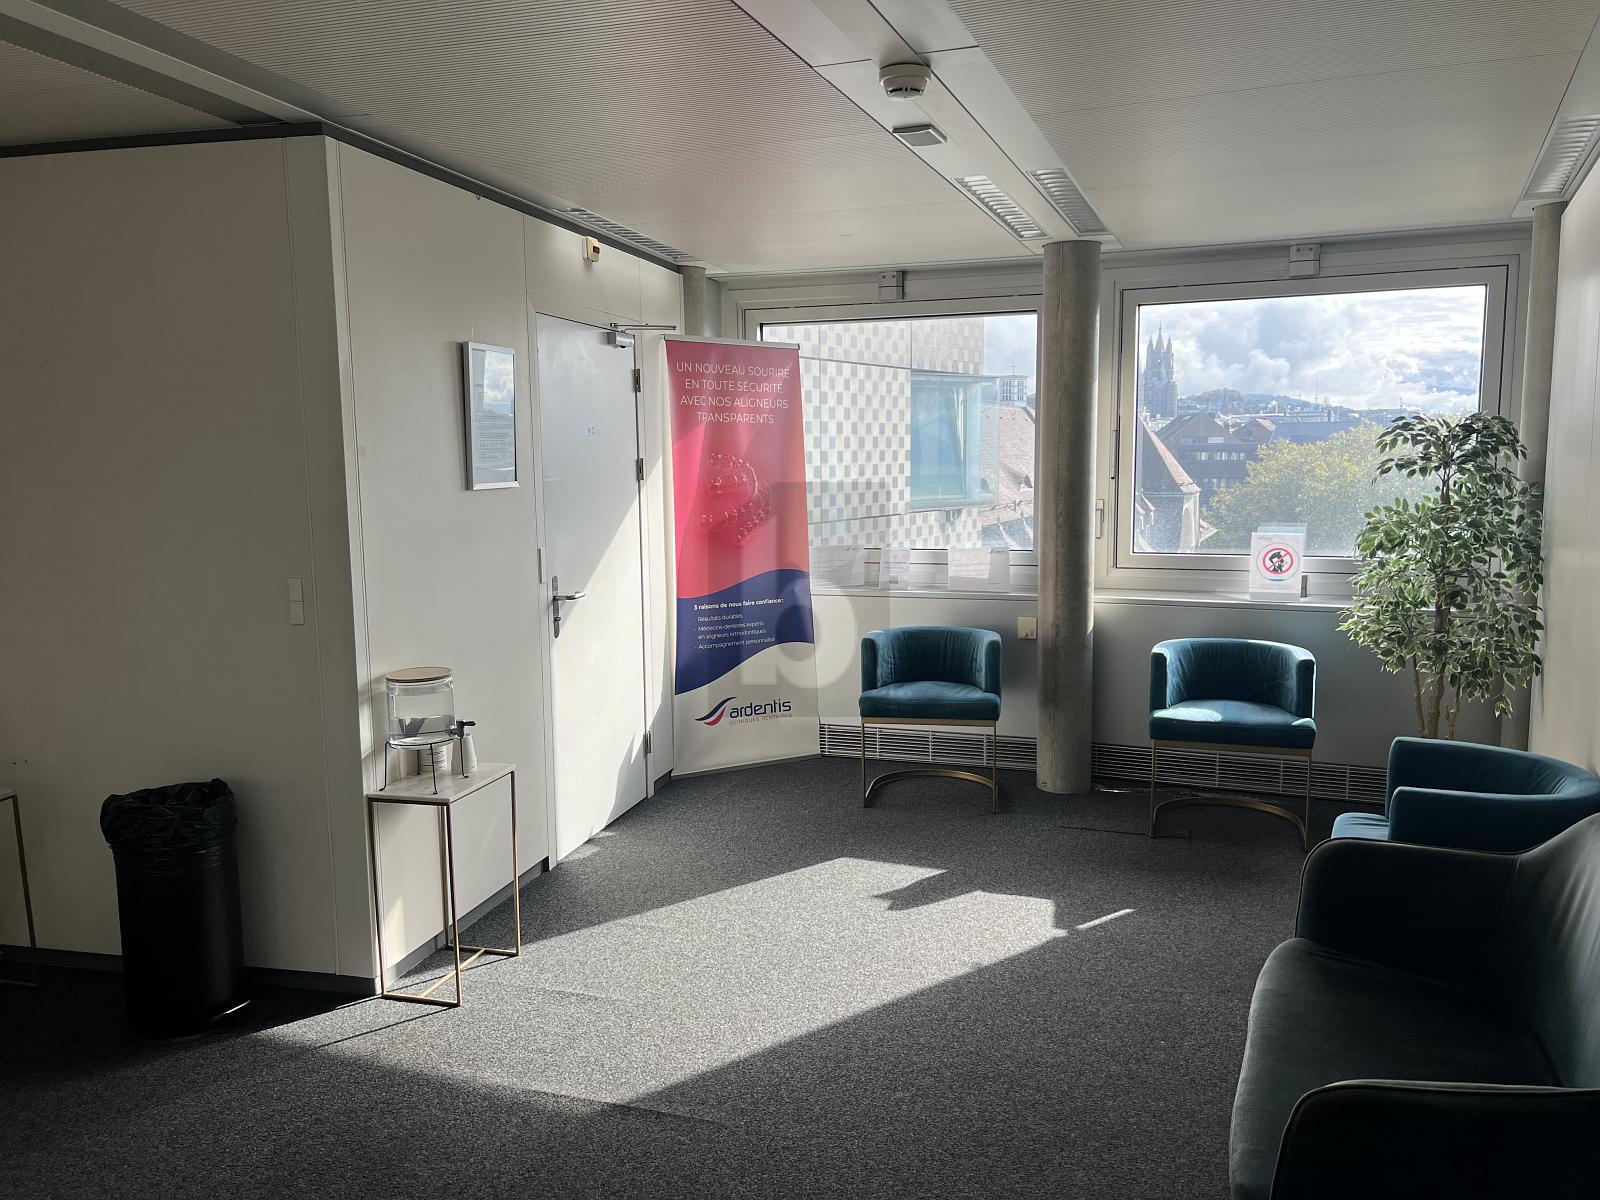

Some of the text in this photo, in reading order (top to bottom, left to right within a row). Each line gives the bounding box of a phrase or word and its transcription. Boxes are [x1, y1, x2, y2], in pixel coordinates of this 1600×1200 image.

[676, 361, 790, 378] UN NOUVEAU SOURIRE
[685, 378, 700, 389] EN
[702, 379, 735, 391] TOUTE
[680, 395, 789, 409] AVEC NOS ALIGNEURS
[696, 411, 774, 424] TRANSPARENTS
[729, 699, 792, 718] ardentis
